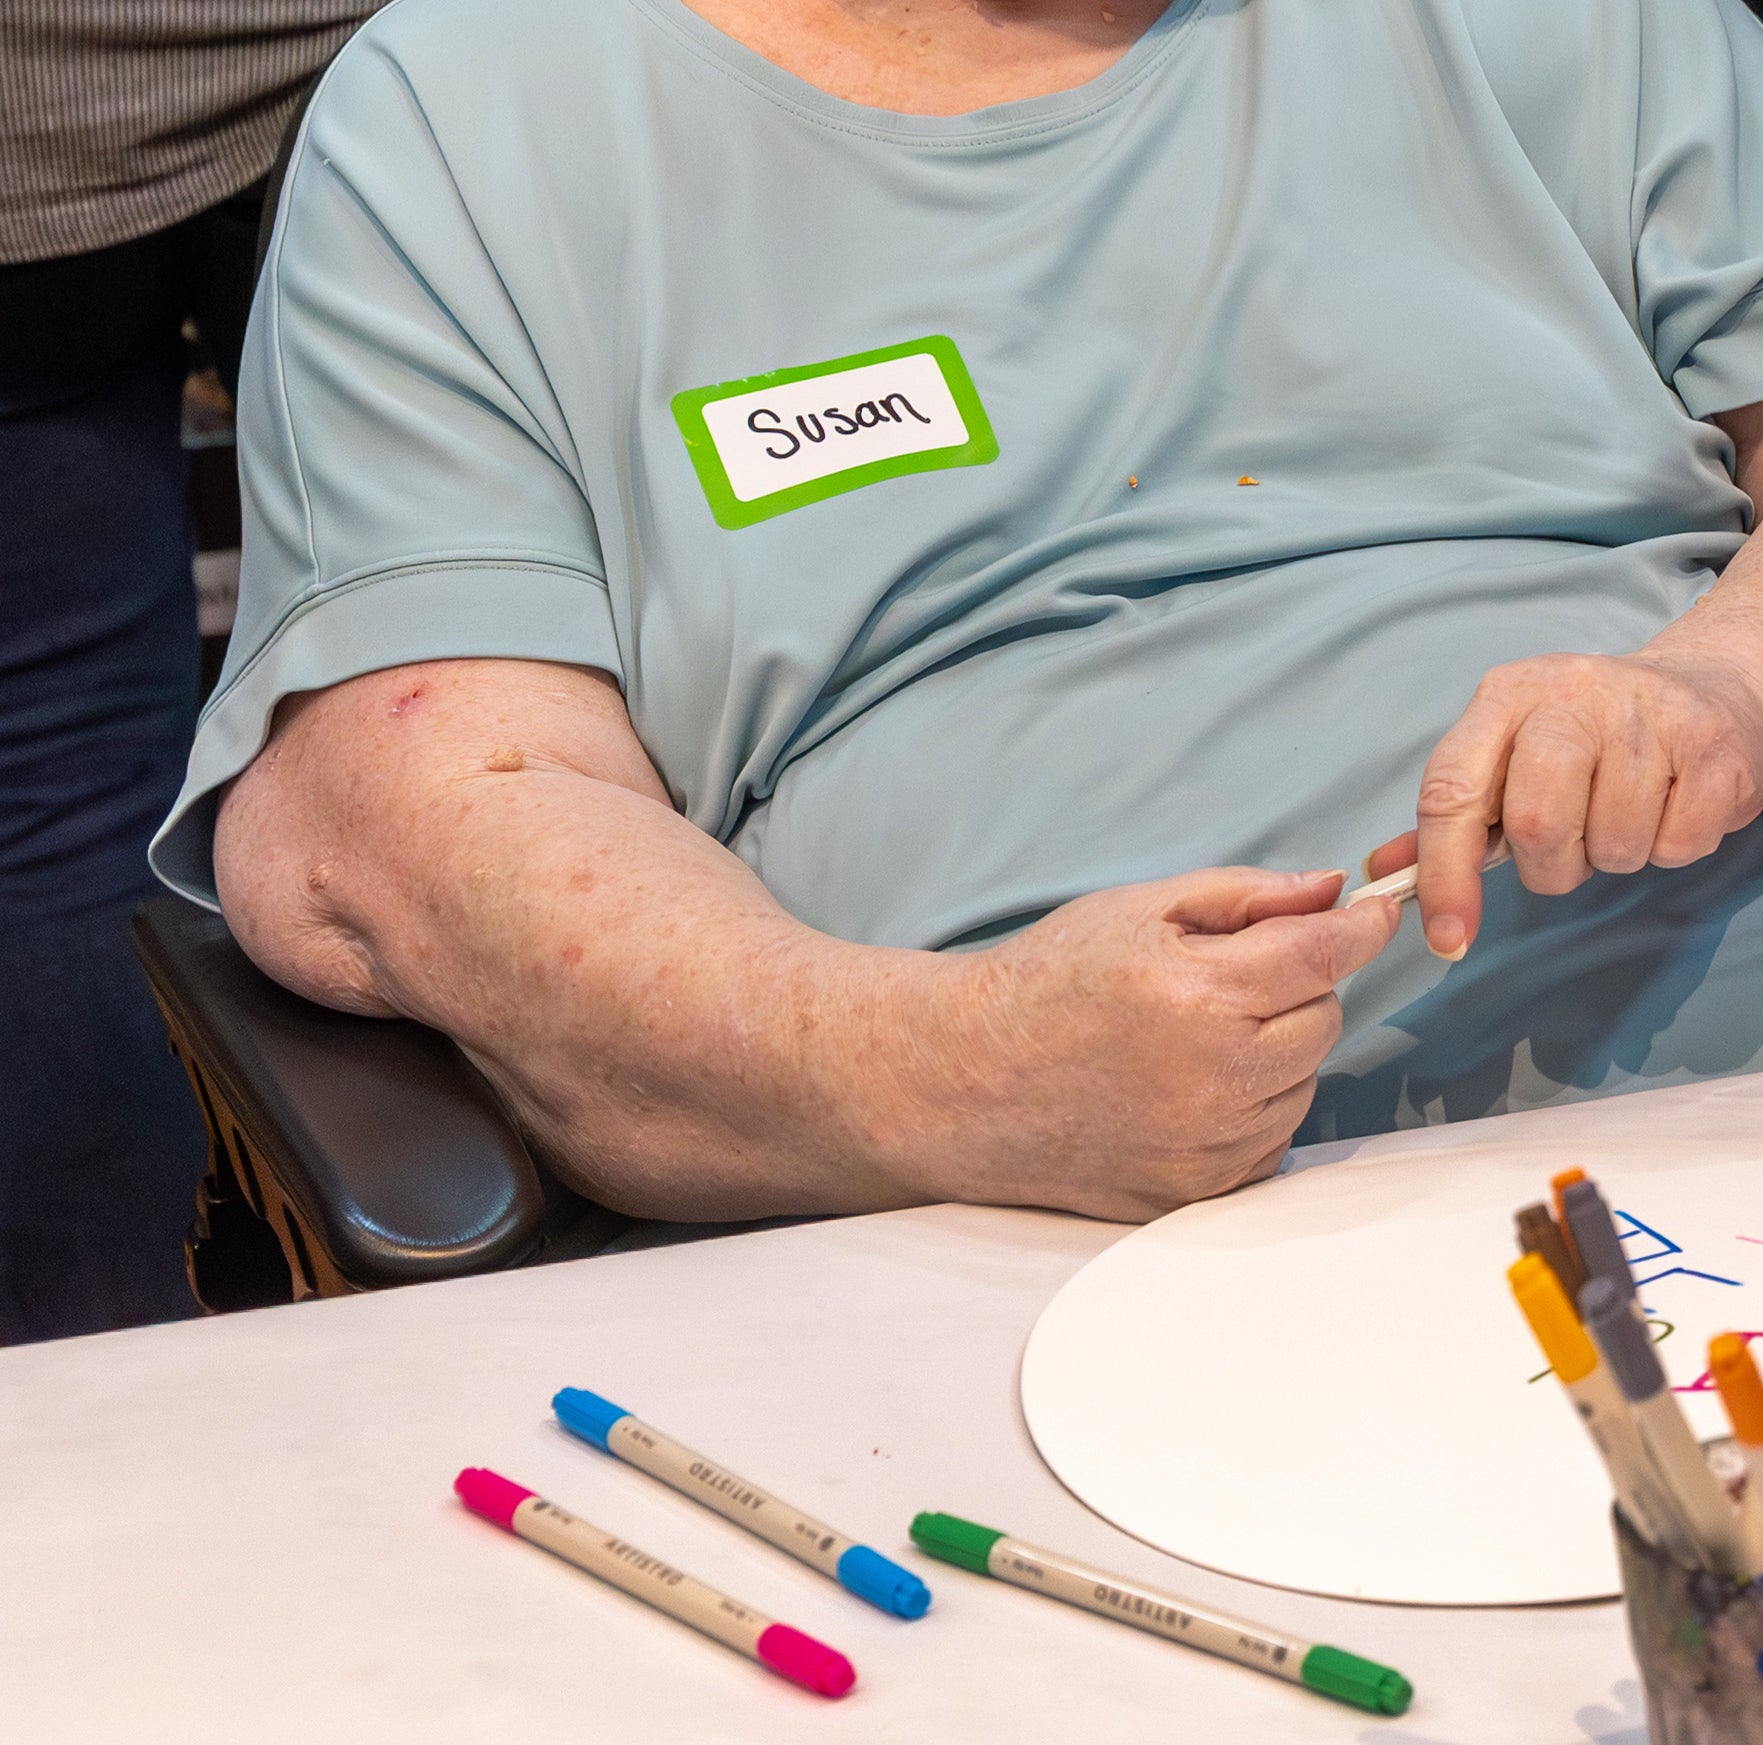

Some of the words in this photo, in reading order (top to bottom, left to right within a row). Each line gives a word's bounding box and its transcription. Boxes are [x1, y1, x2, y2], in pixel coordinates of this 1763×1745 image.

[747, 392, 931, 460] Susan
[688, 1461, 766, 1511] ARTISTRO
[1095, 1585, 1190, 1629] ARTISTRO
